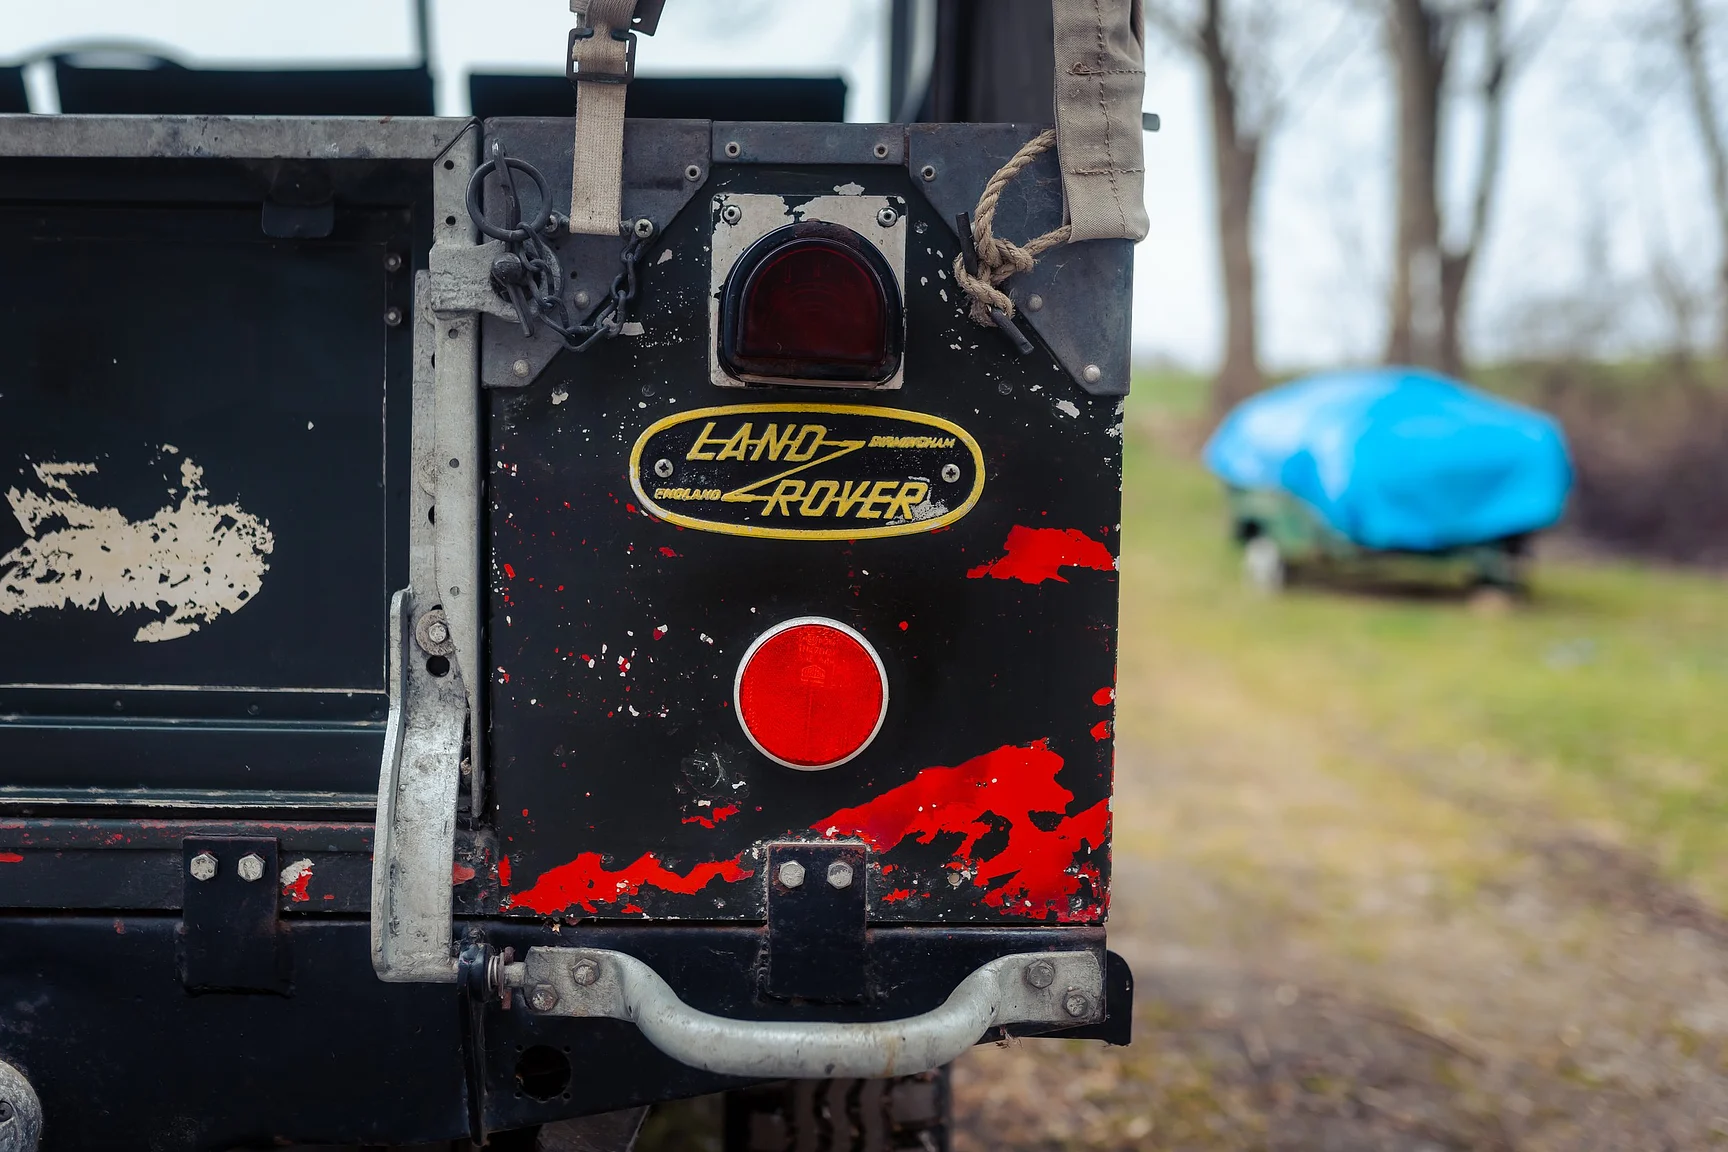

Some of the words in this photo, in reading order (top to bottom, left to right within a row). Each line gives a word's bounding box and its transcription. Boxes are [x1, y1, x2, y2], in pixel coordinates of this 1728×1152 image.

[686, 422, 827, 462] LAND
[868, 435, 956, 448] BIRMINGHAM
[654, 488, 722, 501] ENGLAND
[761, 479, 929, 520] ROVER
